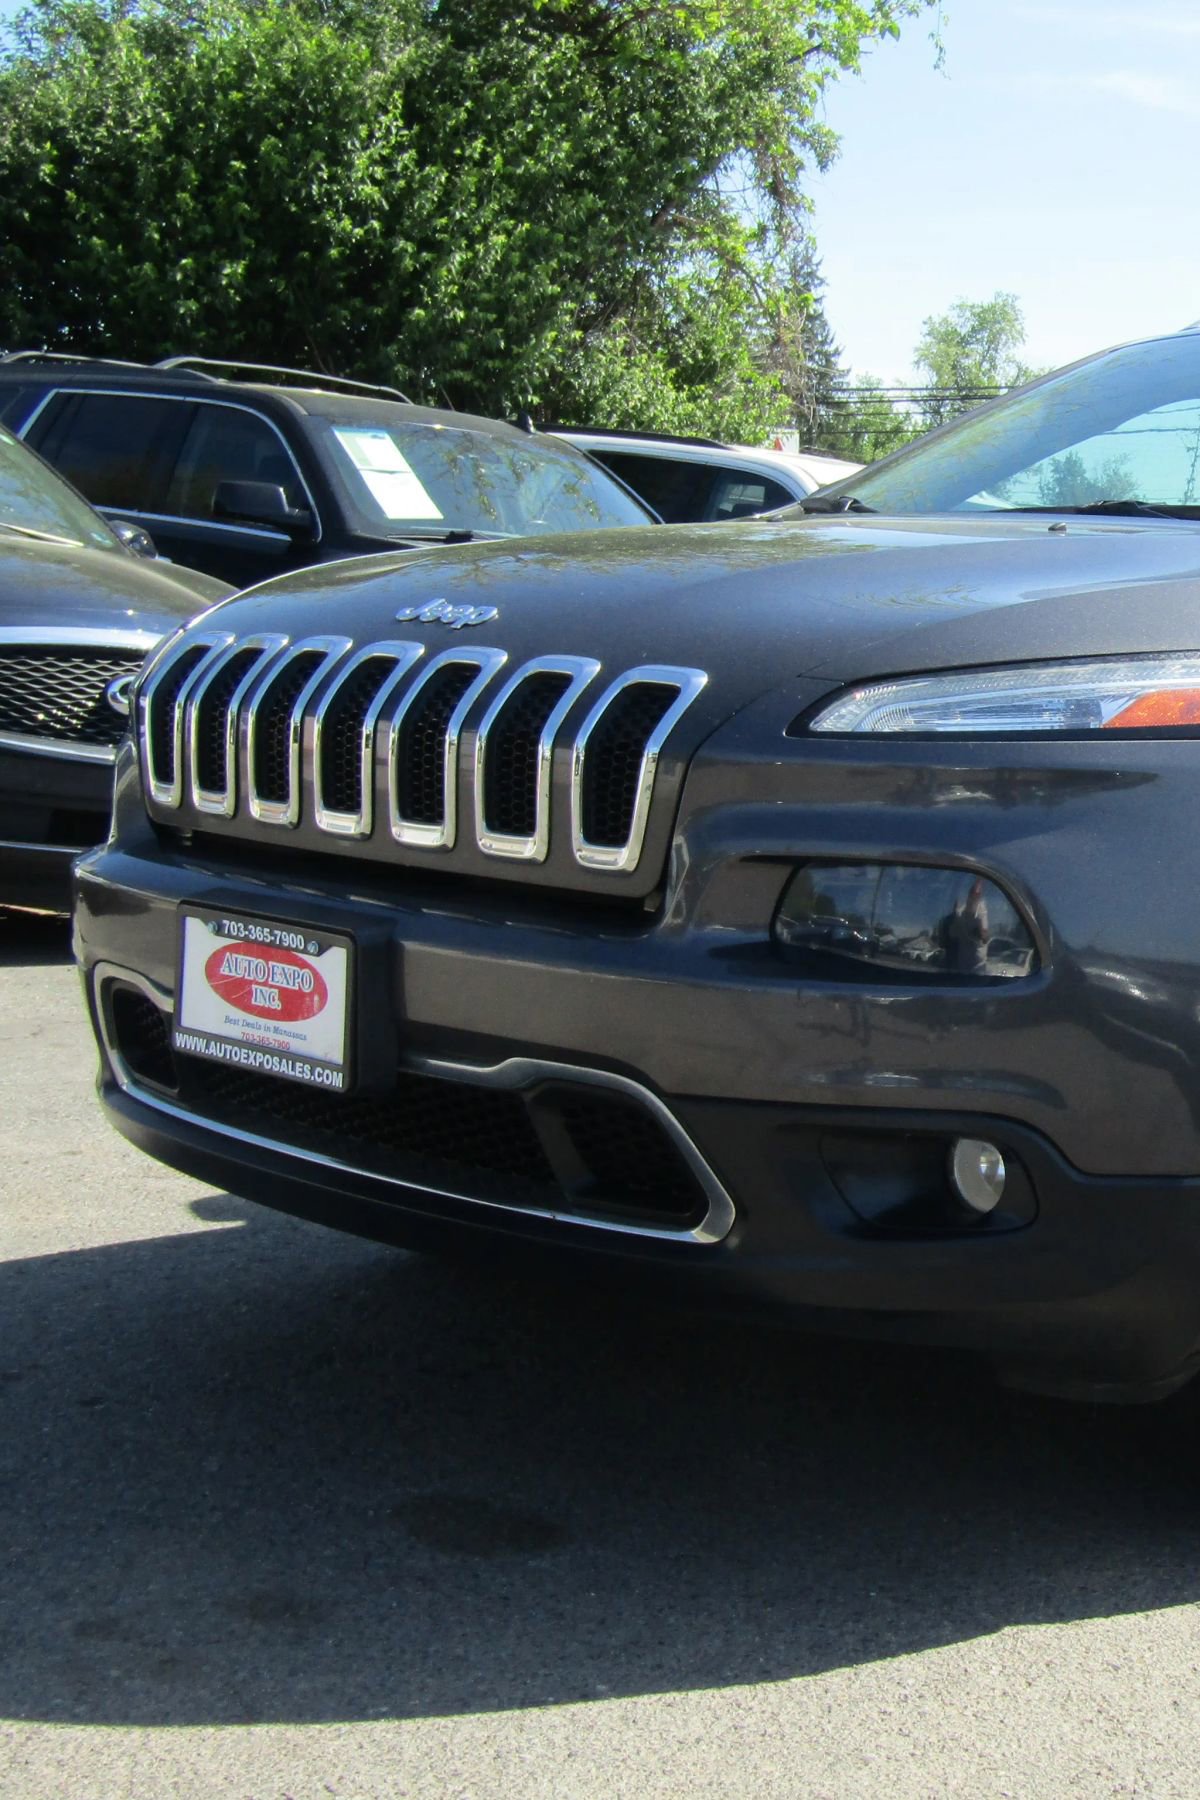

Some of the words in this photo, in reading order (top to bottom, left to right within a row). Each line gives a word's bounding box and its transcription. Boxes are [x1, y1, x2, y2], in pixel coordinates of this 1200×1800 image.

[395, 598, 498, 629] Jeep
[222, 919, 305, 950] 703-365-7900
[221, 952, 268, 982] AUTO
[269, 961, 314, 993] EXPO
[252, 985, 281, 1010] INC.
[224, 1015, 240, 1027] Best
[242, 1019, 262, 1030] Deals
[264, 1024, 271, 1032] in
[242, 1032, 290, 1050] 703-365-7900
[176, 1033, 343, 1088] WWW.AUTOEXPOSALES.COM
